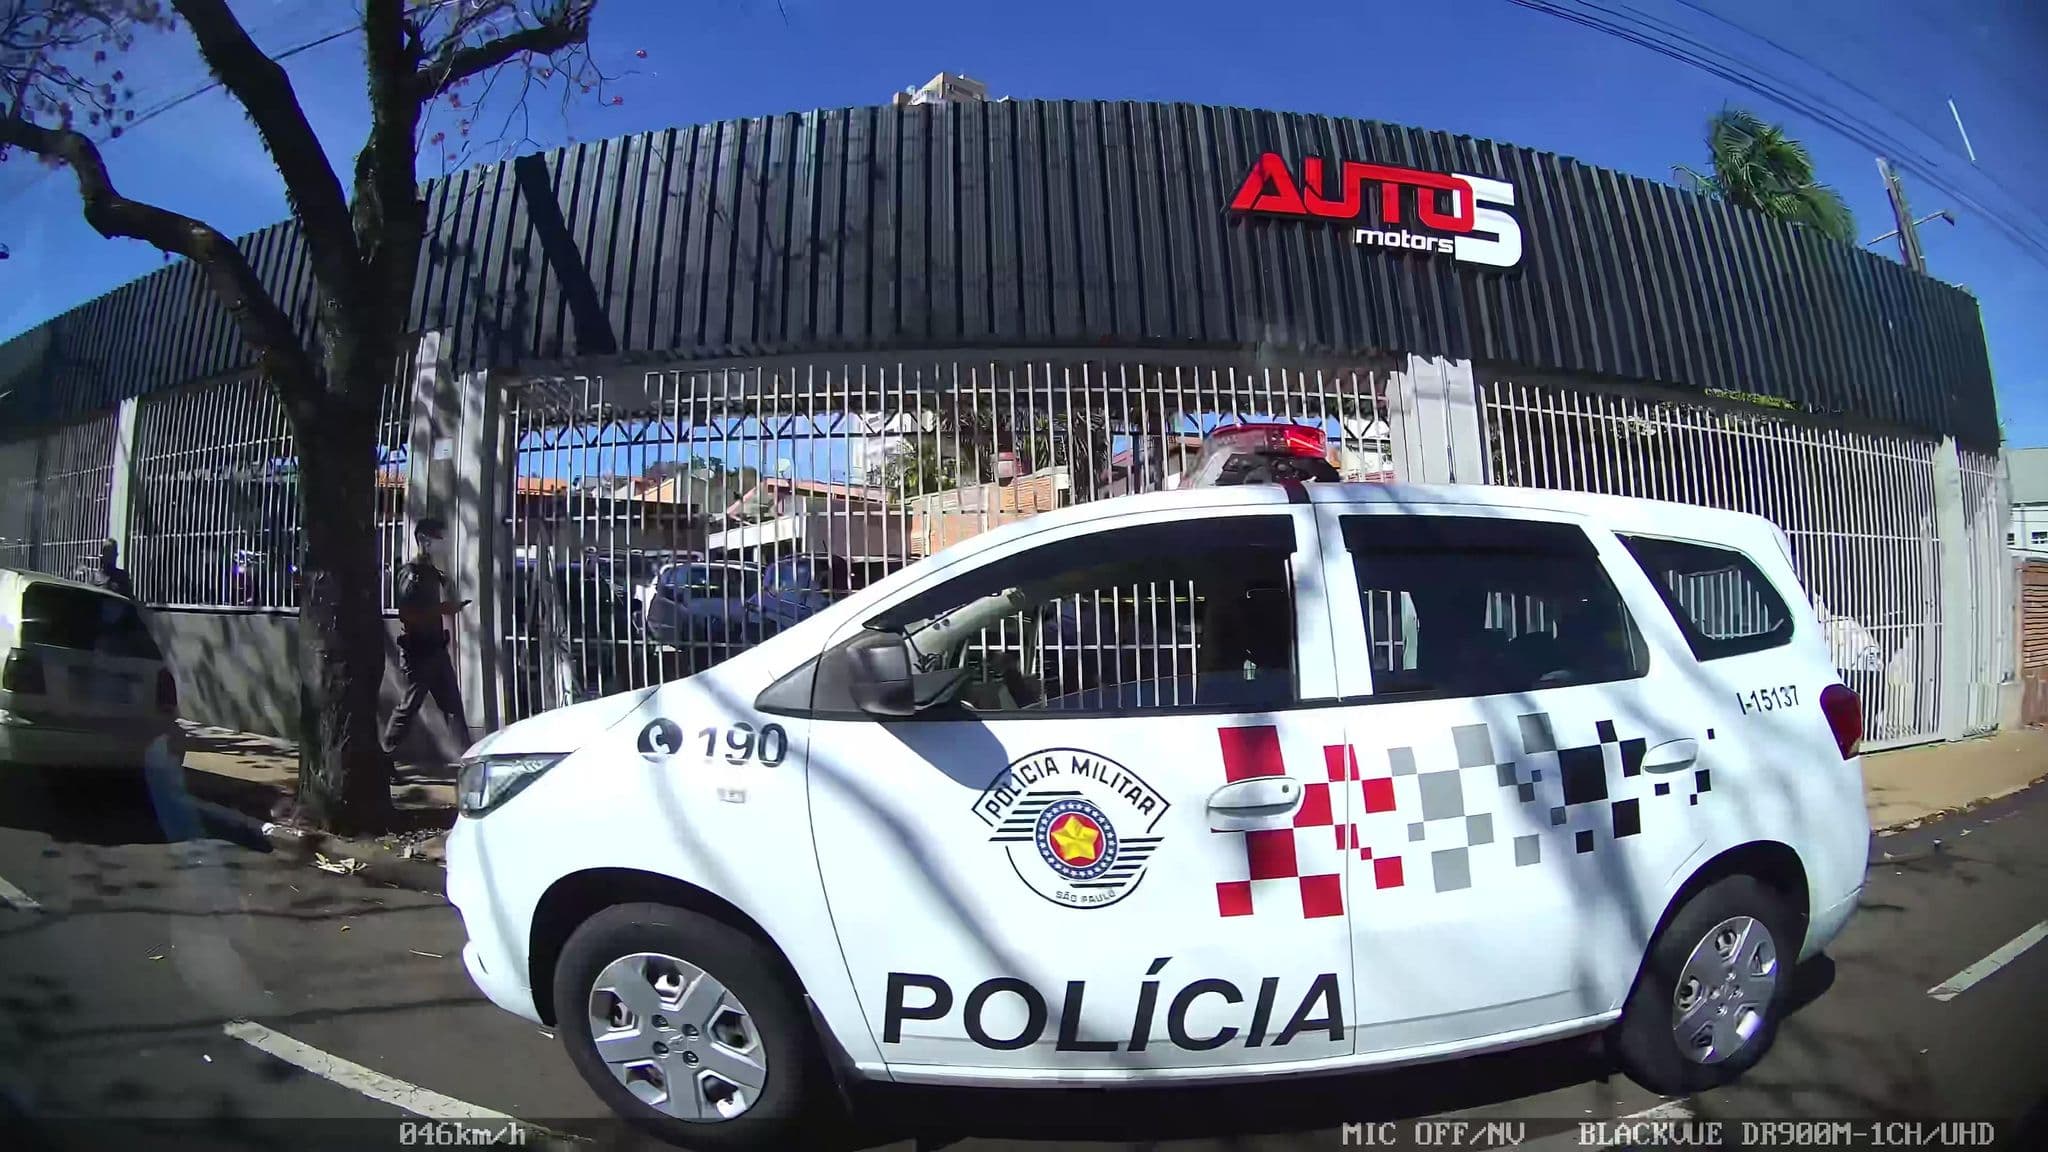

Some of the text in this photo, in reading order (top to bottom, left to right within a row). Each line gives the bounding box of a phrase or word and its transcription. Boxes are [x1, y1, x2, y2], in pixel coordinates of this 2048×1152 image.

[1355, 228, 1454, 254] motors
[698, 721, 789, 769] 190
[1071, 755, 1157, 817] MILITAR
[1080, 888, 1117, 904] PAULO
[883, 956, 1346, 1052] POLÍCIA
